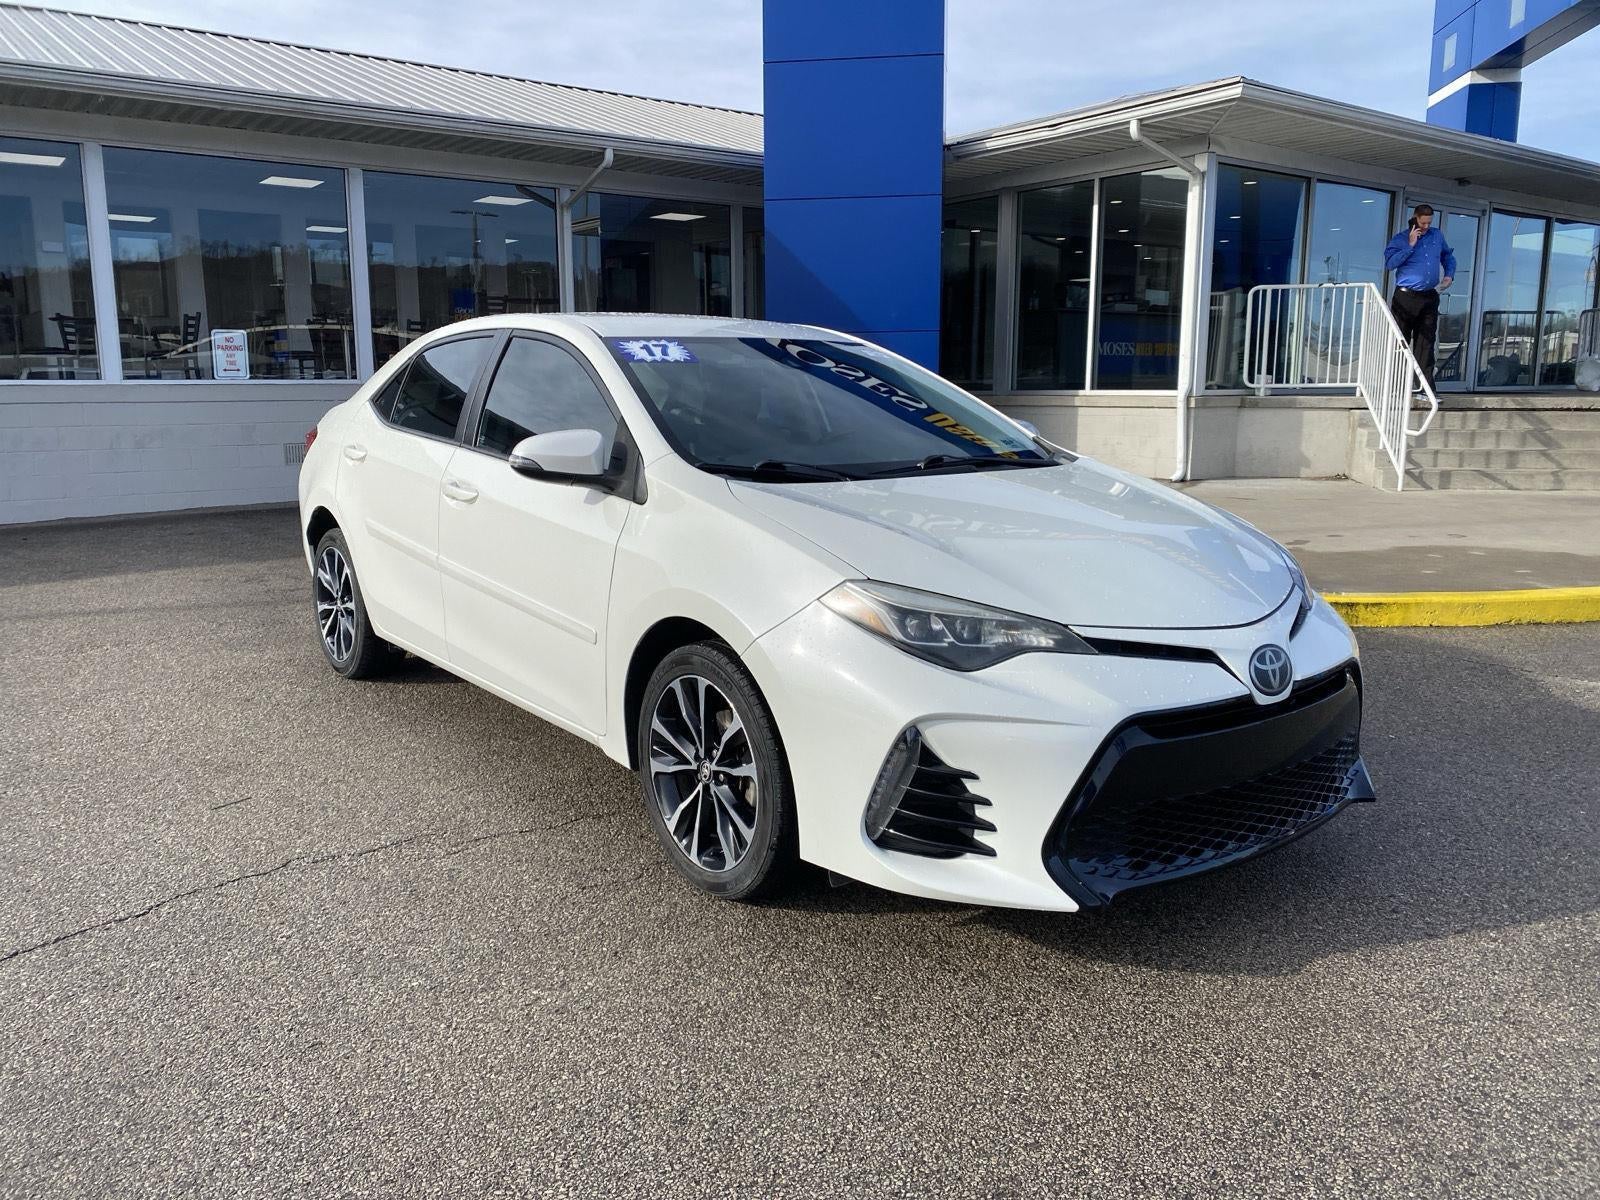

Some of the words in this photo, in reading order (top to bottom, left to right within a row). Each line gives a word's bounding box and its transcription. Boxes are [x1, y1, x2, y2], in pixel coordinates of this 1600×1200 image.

[216, 344, 243, 352] PARKING
[640, 343, 670, 357] 17
[1097, 341, 1135, 356] MOSES
